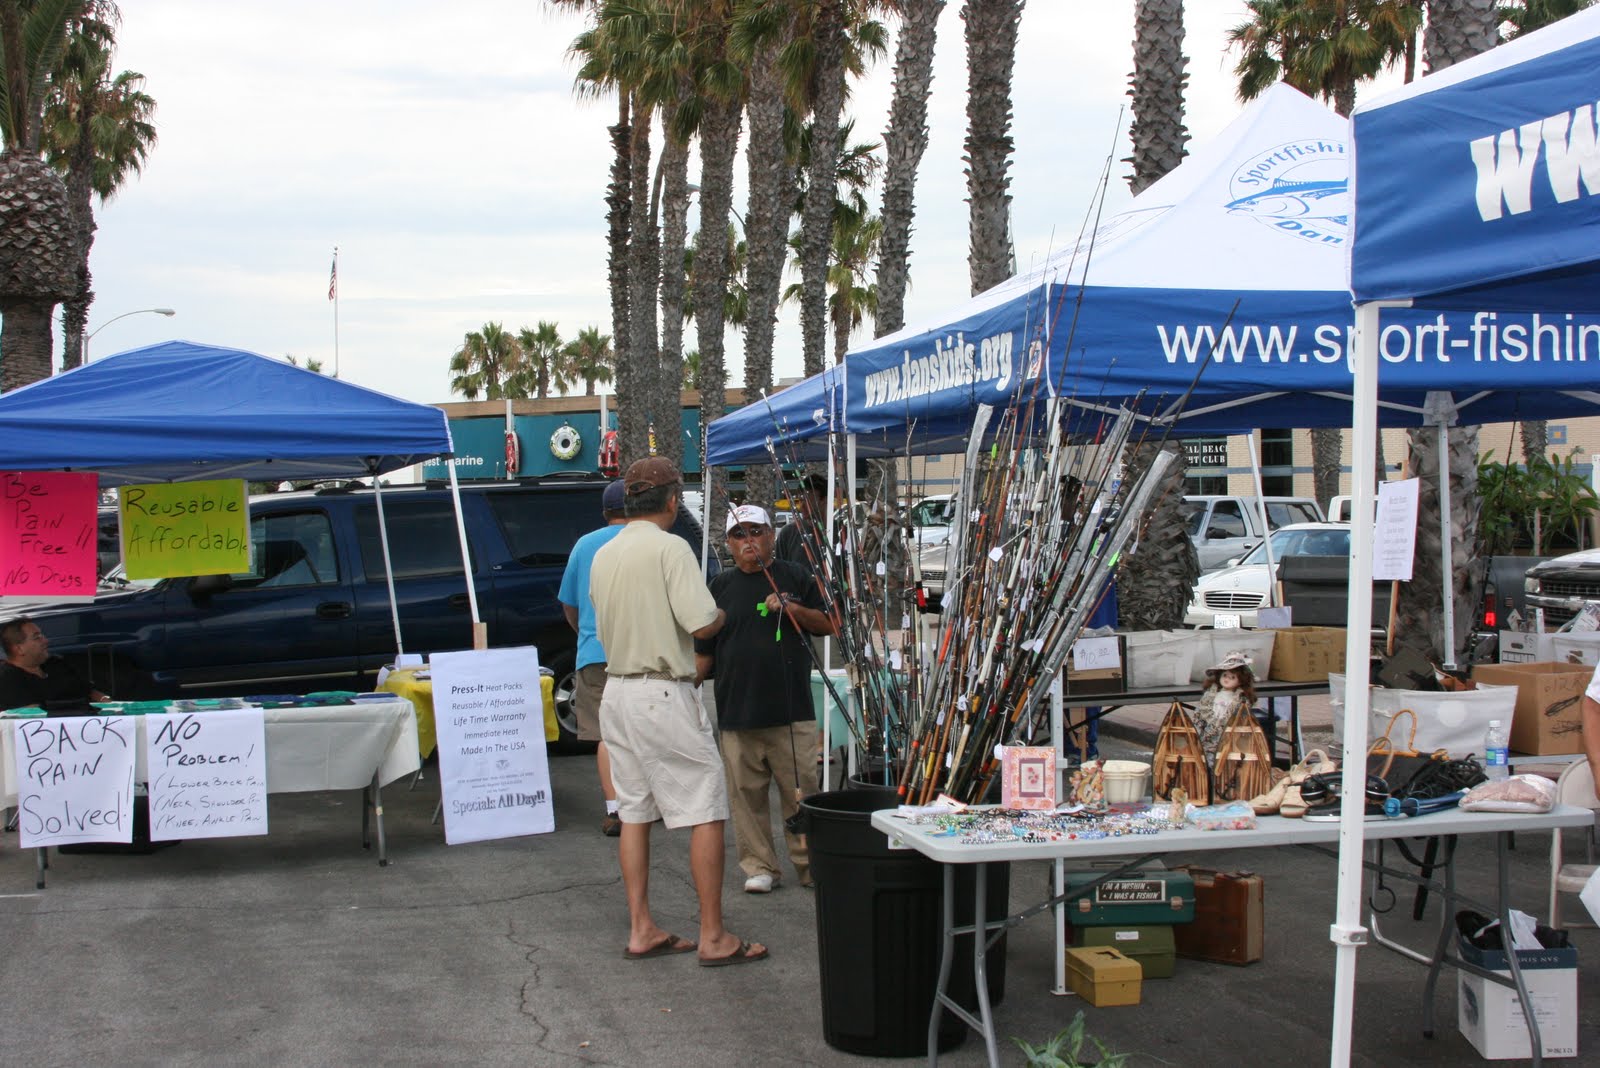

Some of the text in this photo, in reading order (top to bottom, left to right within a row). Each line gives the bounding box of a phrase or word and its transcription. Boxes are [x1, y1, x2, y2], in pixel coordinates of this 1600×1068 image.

[864, 331, 1013, 408] www.danskids.org
[445, 455, 484, 466] arine
[1202, 455, 1226, 463] CLUB
[4, 474, 48, 499] Be
[125, 488, 239, 517] Reusable
[128, 524, 248, 558] Affordable
[38, 565, 83, 588] Drugs
[451, 682, 523, 695] Press-It Heat Packs
[451, 700, 483, 710] Reusable
[490, 697, 525, 708] Affordable
[155, 714, 201, 745] NO
[453, 712, 527, 727] Life Time Warranty
[19, 718, 127, 758] BACK
[464, 728, 519, 740] Immediate Heat
[461, 741, 526, 755] Made In The USA
[28, 753, 103, 787] PAIN
[23, 765, 133, 836] Solved!
[452, 790, 546, 816] Specials All Day!!
[1113, 892, 1129, 900] WAS
[1129, 892, 1135, 900] A
[1114, 882, 1120, 890] A
